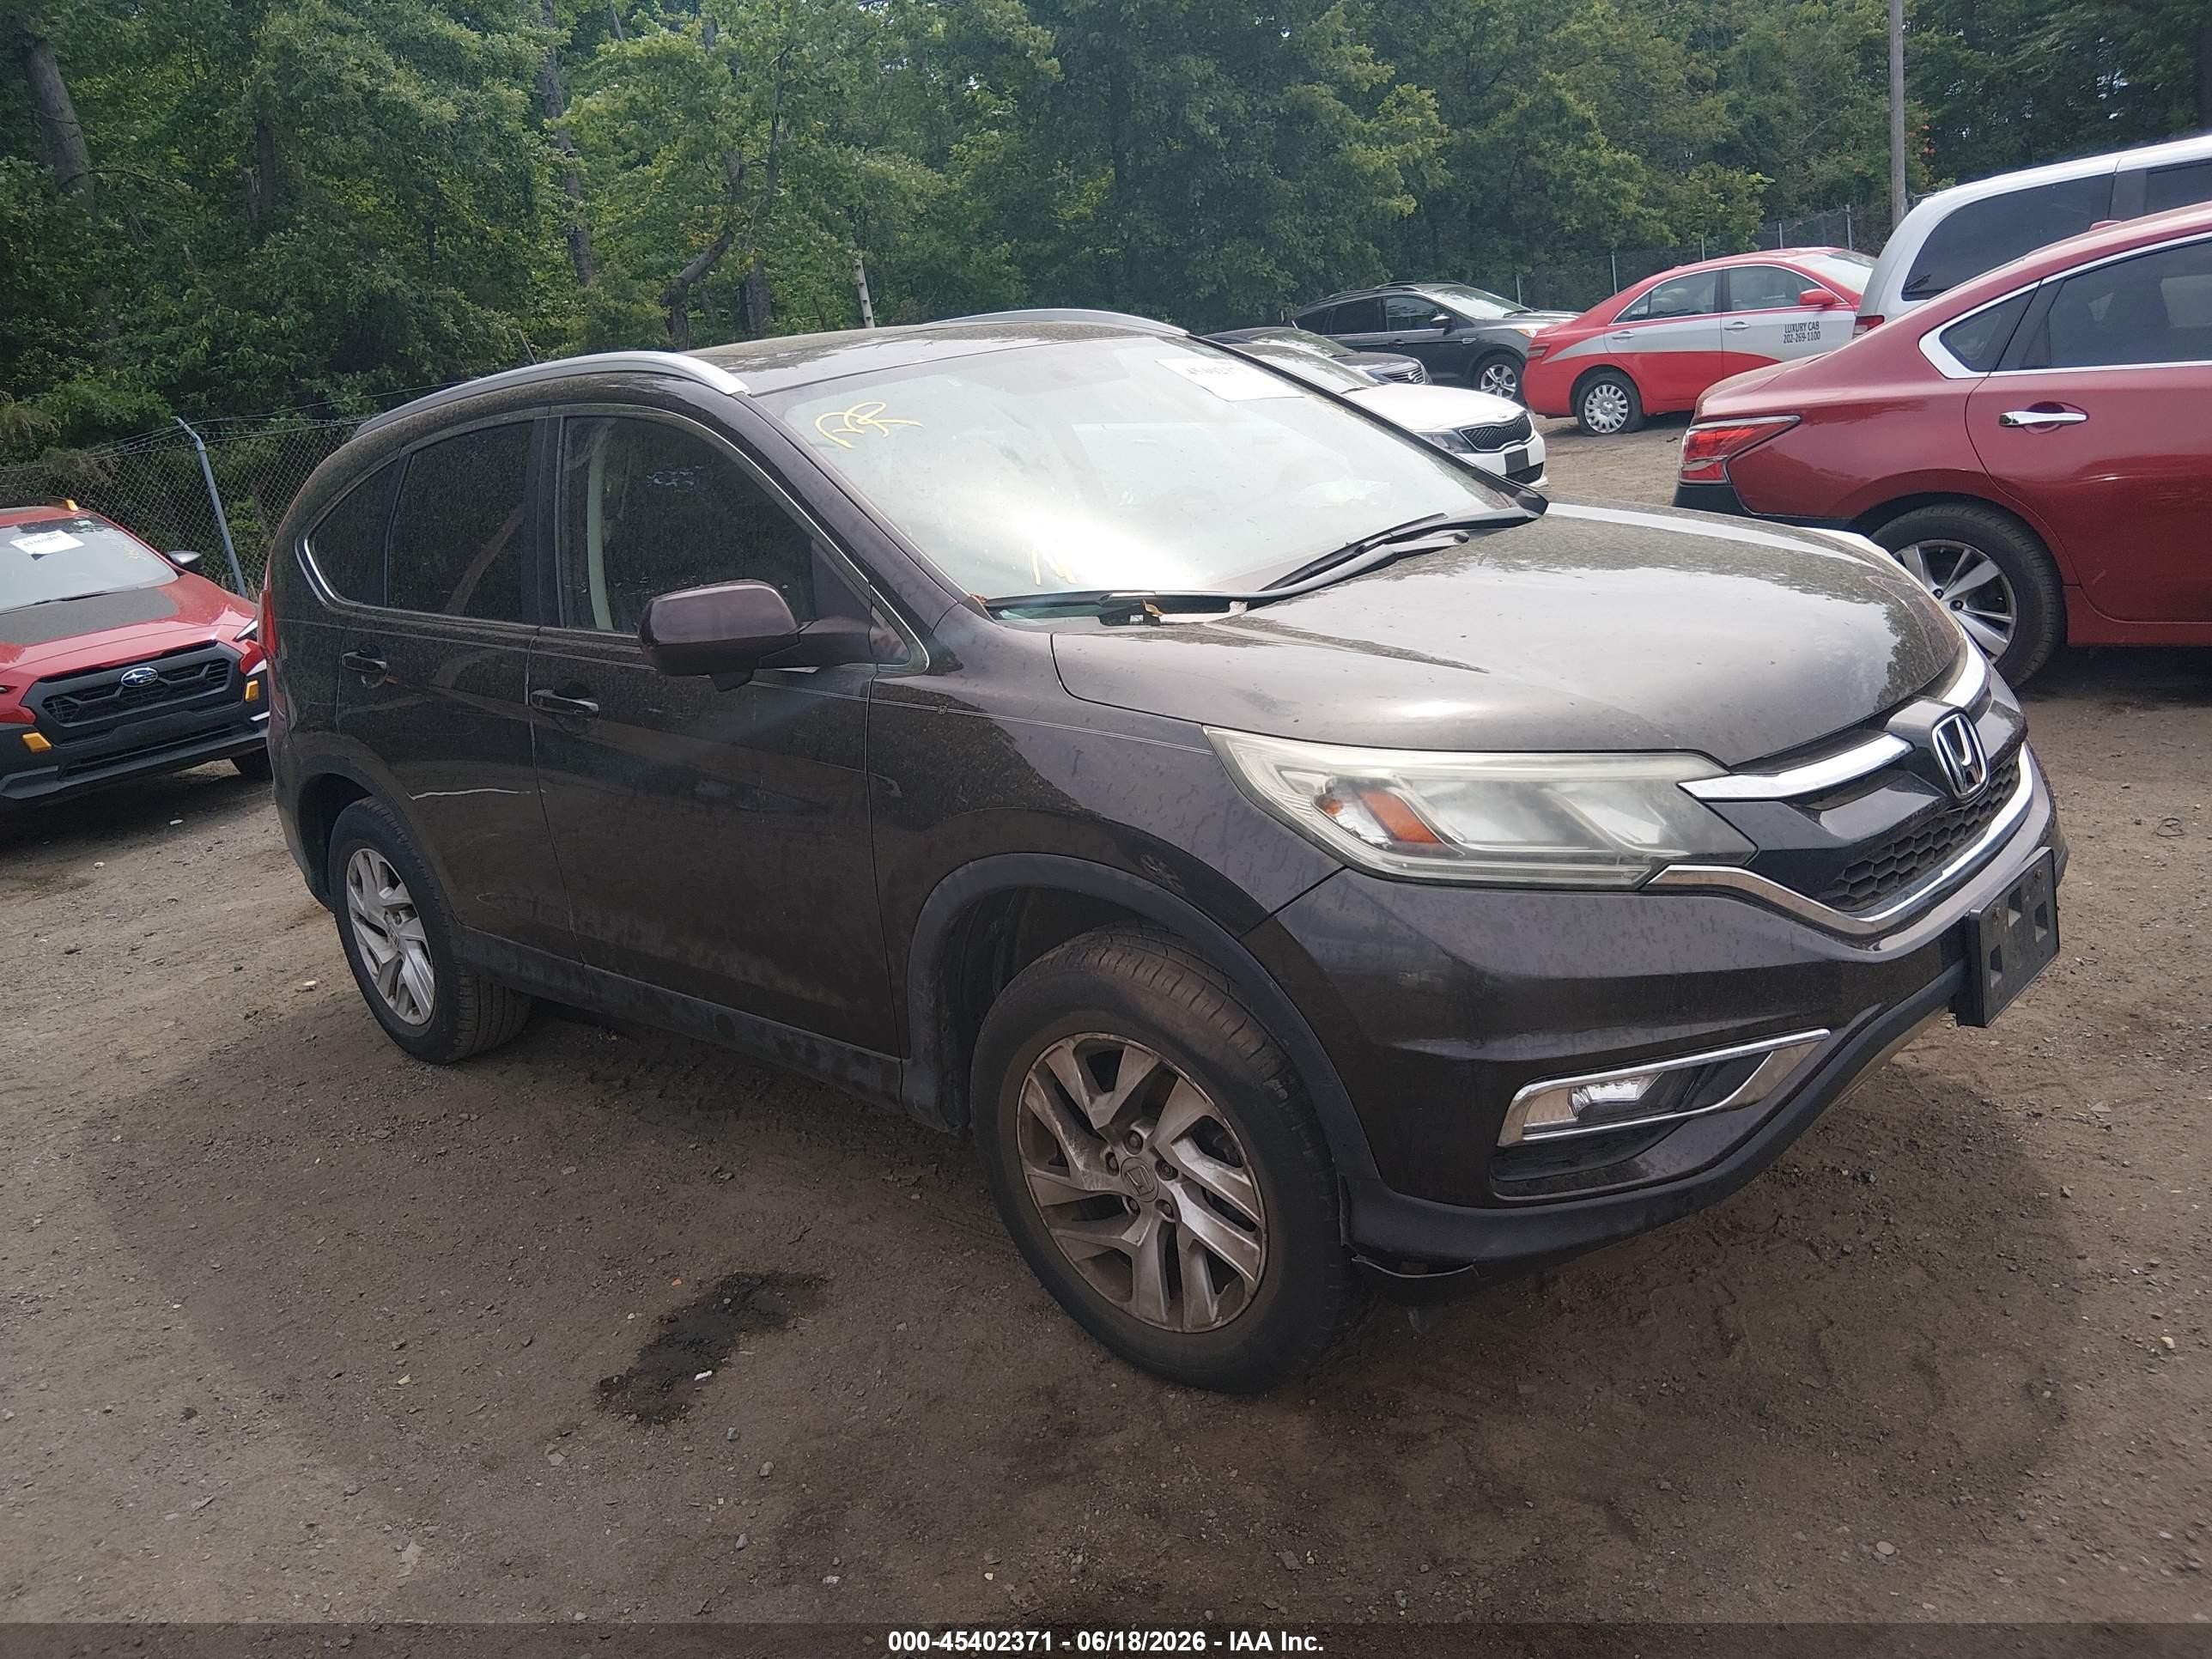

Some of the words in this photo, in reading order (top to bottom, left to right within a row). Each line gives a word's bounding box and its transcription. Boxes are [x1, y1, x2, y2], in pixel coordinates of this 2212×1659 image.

[1784, 322, 1807, 333] LUXURY
[1808, 320, 1820, 331] CAB
[1784, 331, 1820, 343] 202-269-1100
